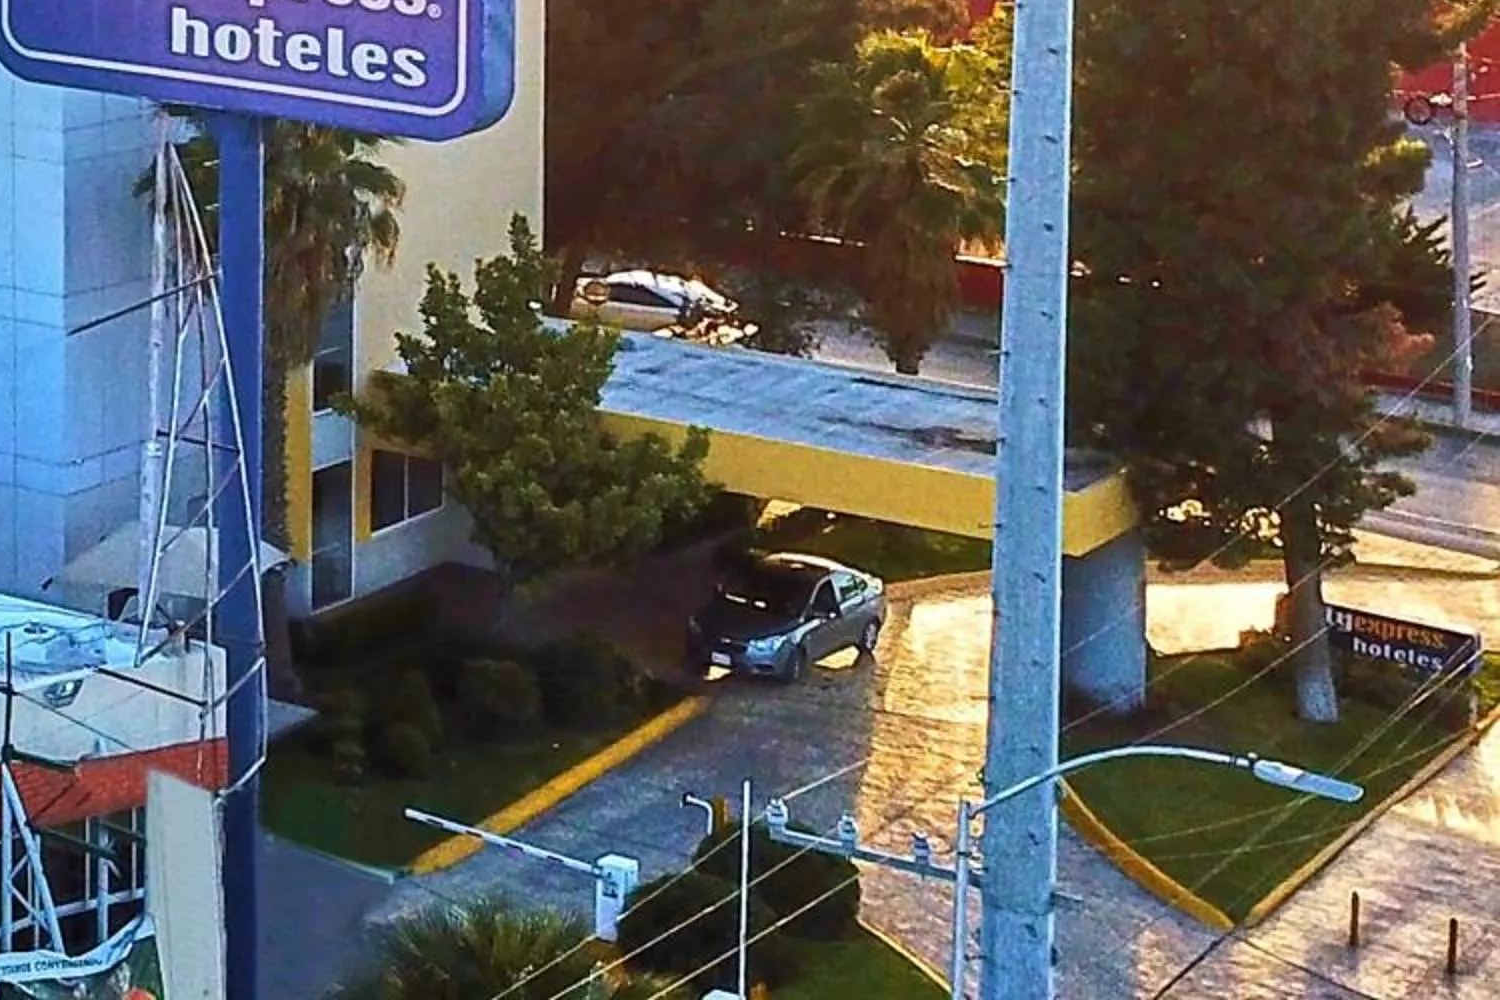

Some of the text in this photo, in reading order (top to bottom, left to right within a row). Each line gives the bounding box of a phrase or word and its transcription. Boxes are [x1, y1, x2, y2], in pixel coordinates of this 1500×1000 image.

[170, 6, 428, 88] hoteles
[1324, 606, 1447, 649] tyexpress
[1352, 636, 1444, 672] hoteles
